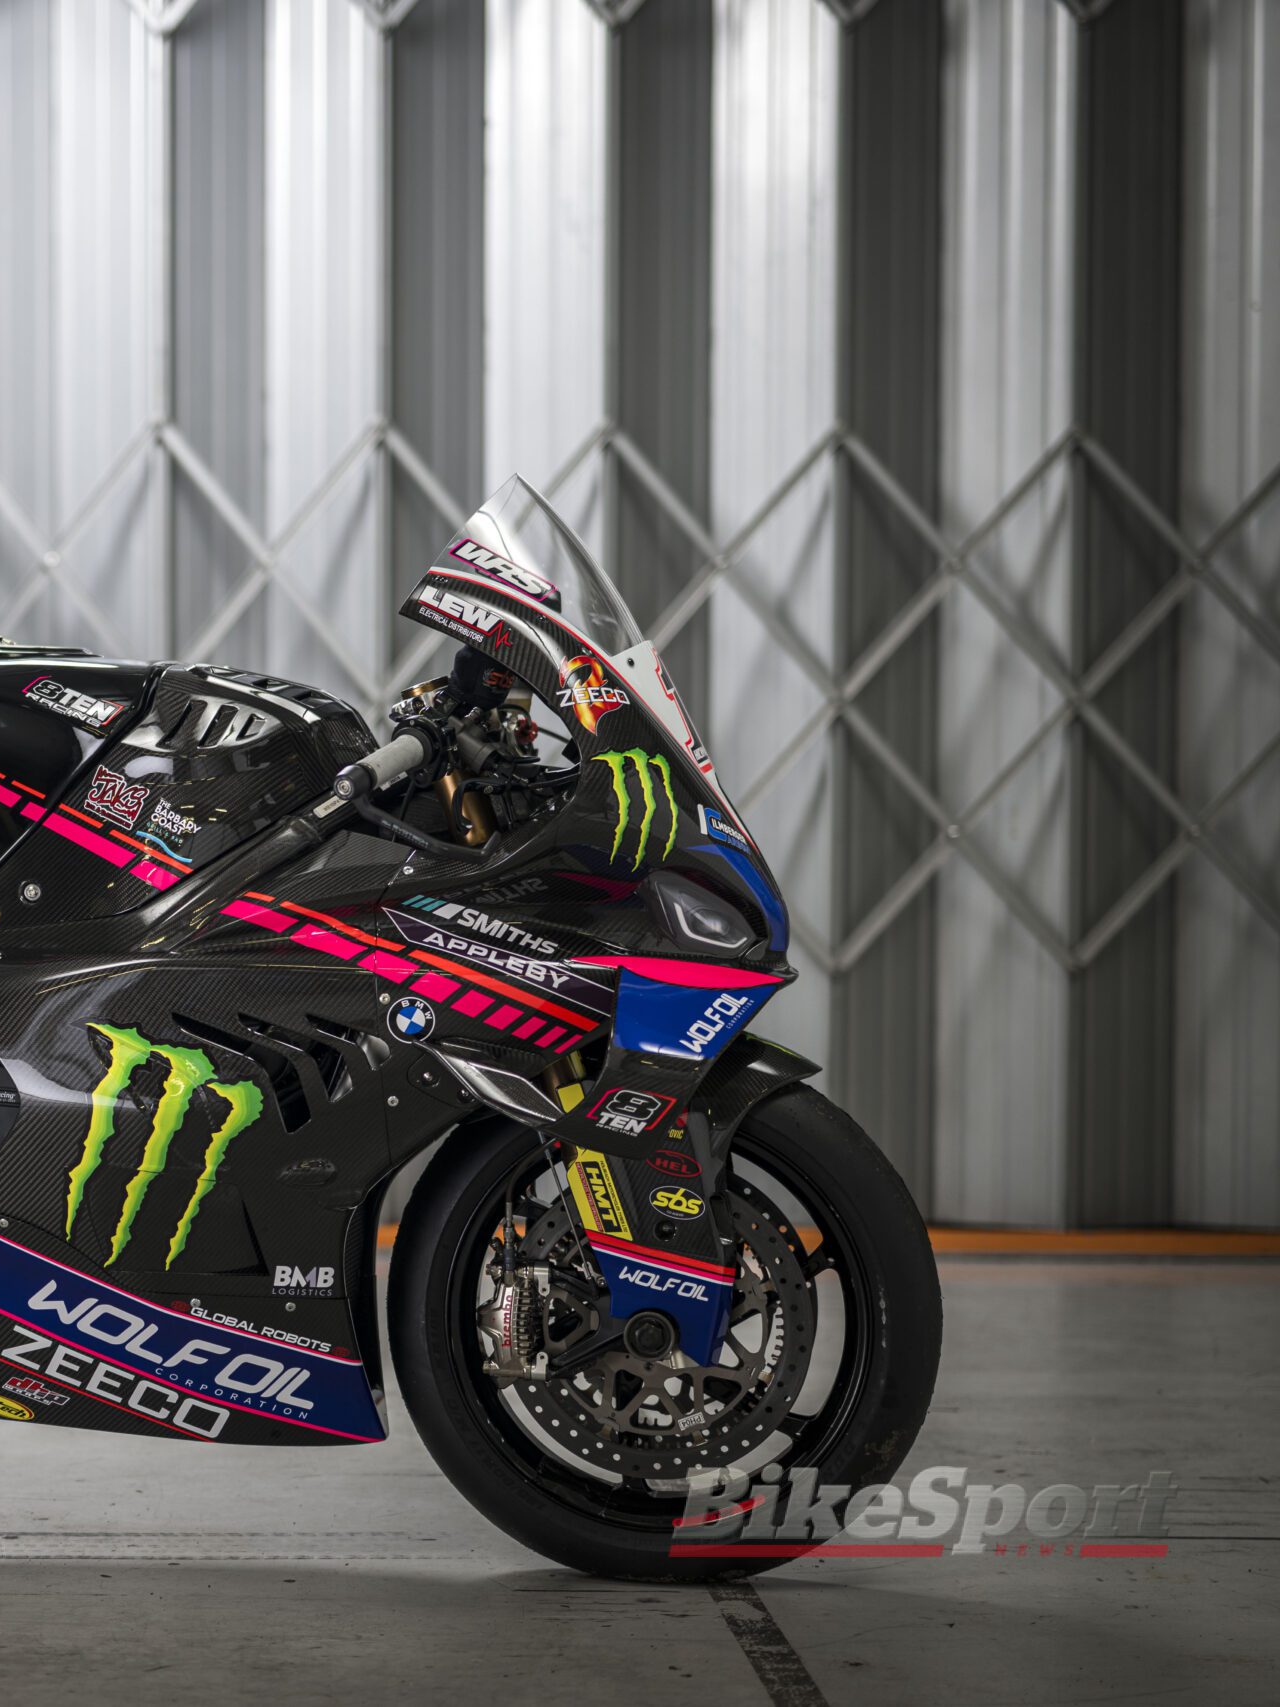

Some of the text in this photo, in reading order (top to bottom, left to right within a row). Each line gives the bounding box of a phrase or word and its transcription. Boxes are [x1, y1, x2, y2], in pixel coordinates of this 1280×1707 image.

[455, 541, 552, 595] WRS
[419, 585, 501, 632] LEW
[419, 606, 485, 643] ELECTRICAL DISTRIBUTORS
[25, 692, 102, 728] RACING
[556, 686, 631, 708] ZEECO
[155, 805, 202, 834] BARBARY
[159, 797, 172, 810] THE
[151, 812, 183, 835] COAST
[457, 908, 559, 955] SMITHS
[422, 932, 570, 990] APPLEBY
[401, 999, 433, 1020] BMW
[605, 1089, 662, 1121] 8
[595, 1123, 639, 1137] RACING
[599, 1111, 648, 1134] TEN
[655, 1157, 692, 1174] HEL
[585, 1167, 618, 1227] HMT
[271, 1287, 334, 1297] LOGISTICS
[273, 1265, 335, 1289] BMB
[190, 1306, 332, 1353] GLOBAL ROBOTS
[501, 1295, 513, 1348] brembo
[1, 1324, 230, 1439] ZEECO
[154, 1366, 310, 1420] CORPORATION
